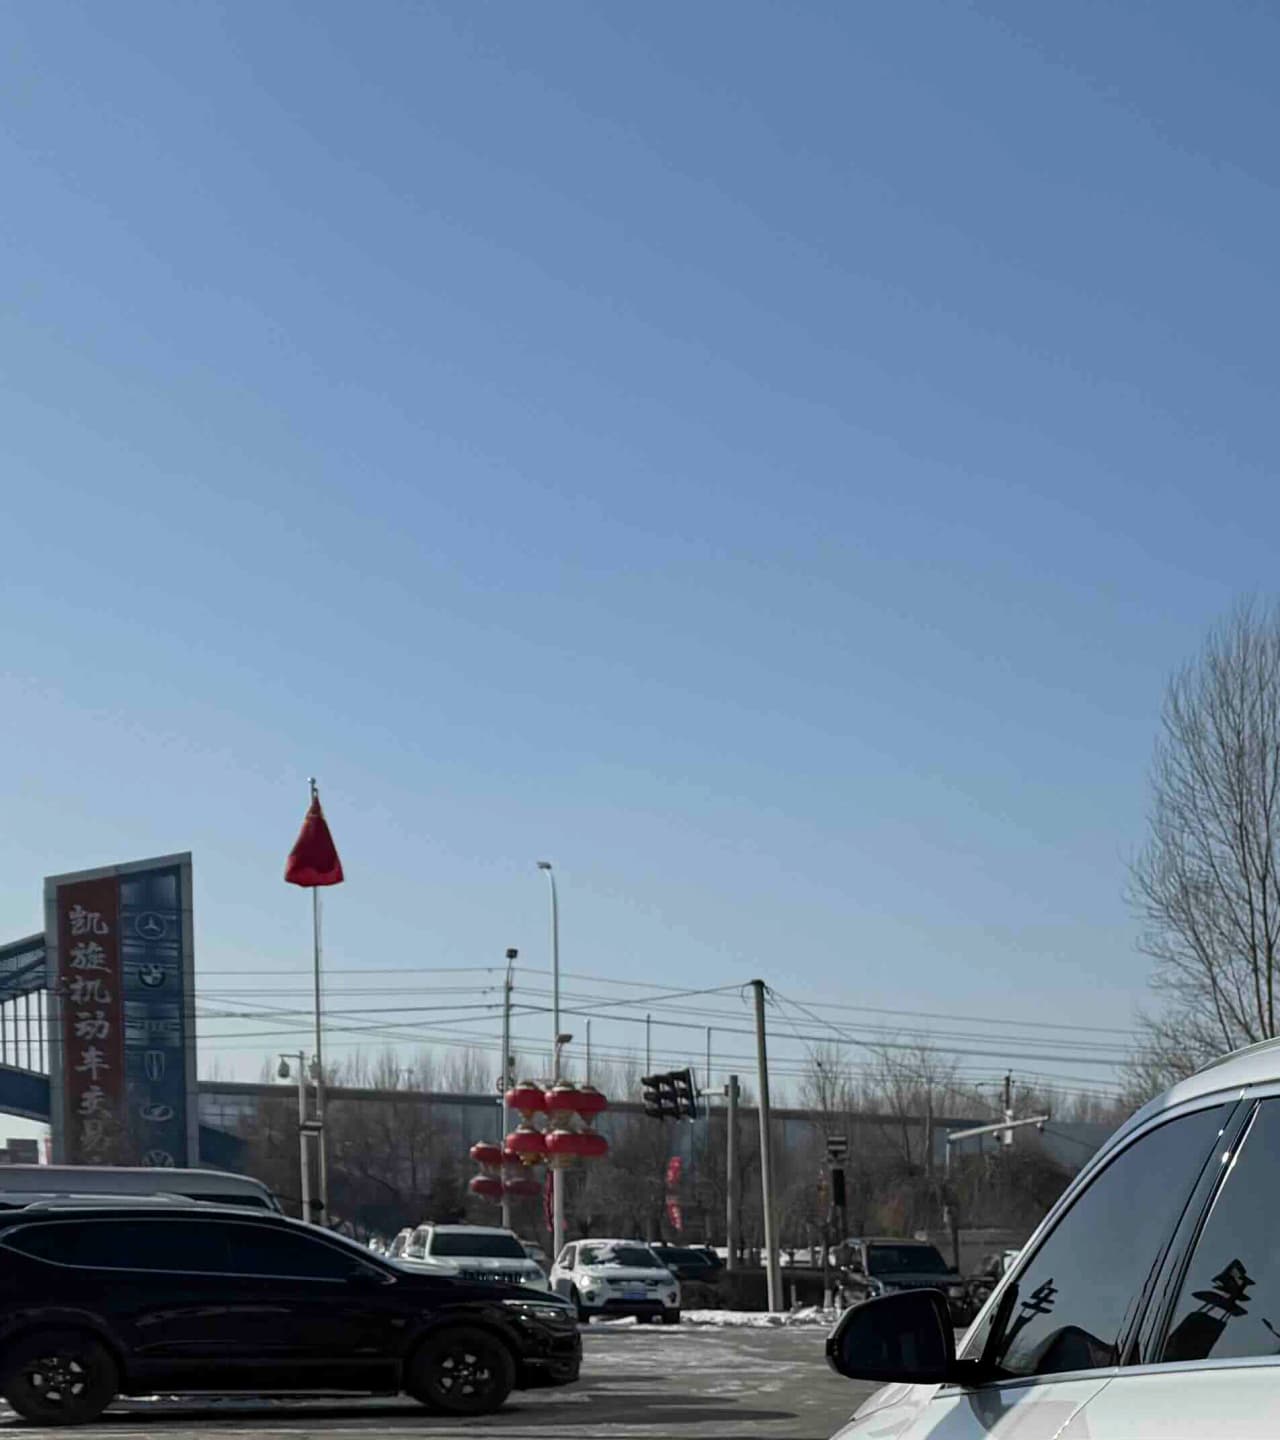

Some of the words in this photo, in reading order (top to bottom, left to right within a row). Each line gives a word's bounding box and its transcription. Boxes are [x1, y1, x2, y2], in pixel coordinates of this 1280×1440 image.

[67, 903, 114, 1164] 凯旋机动车交易
